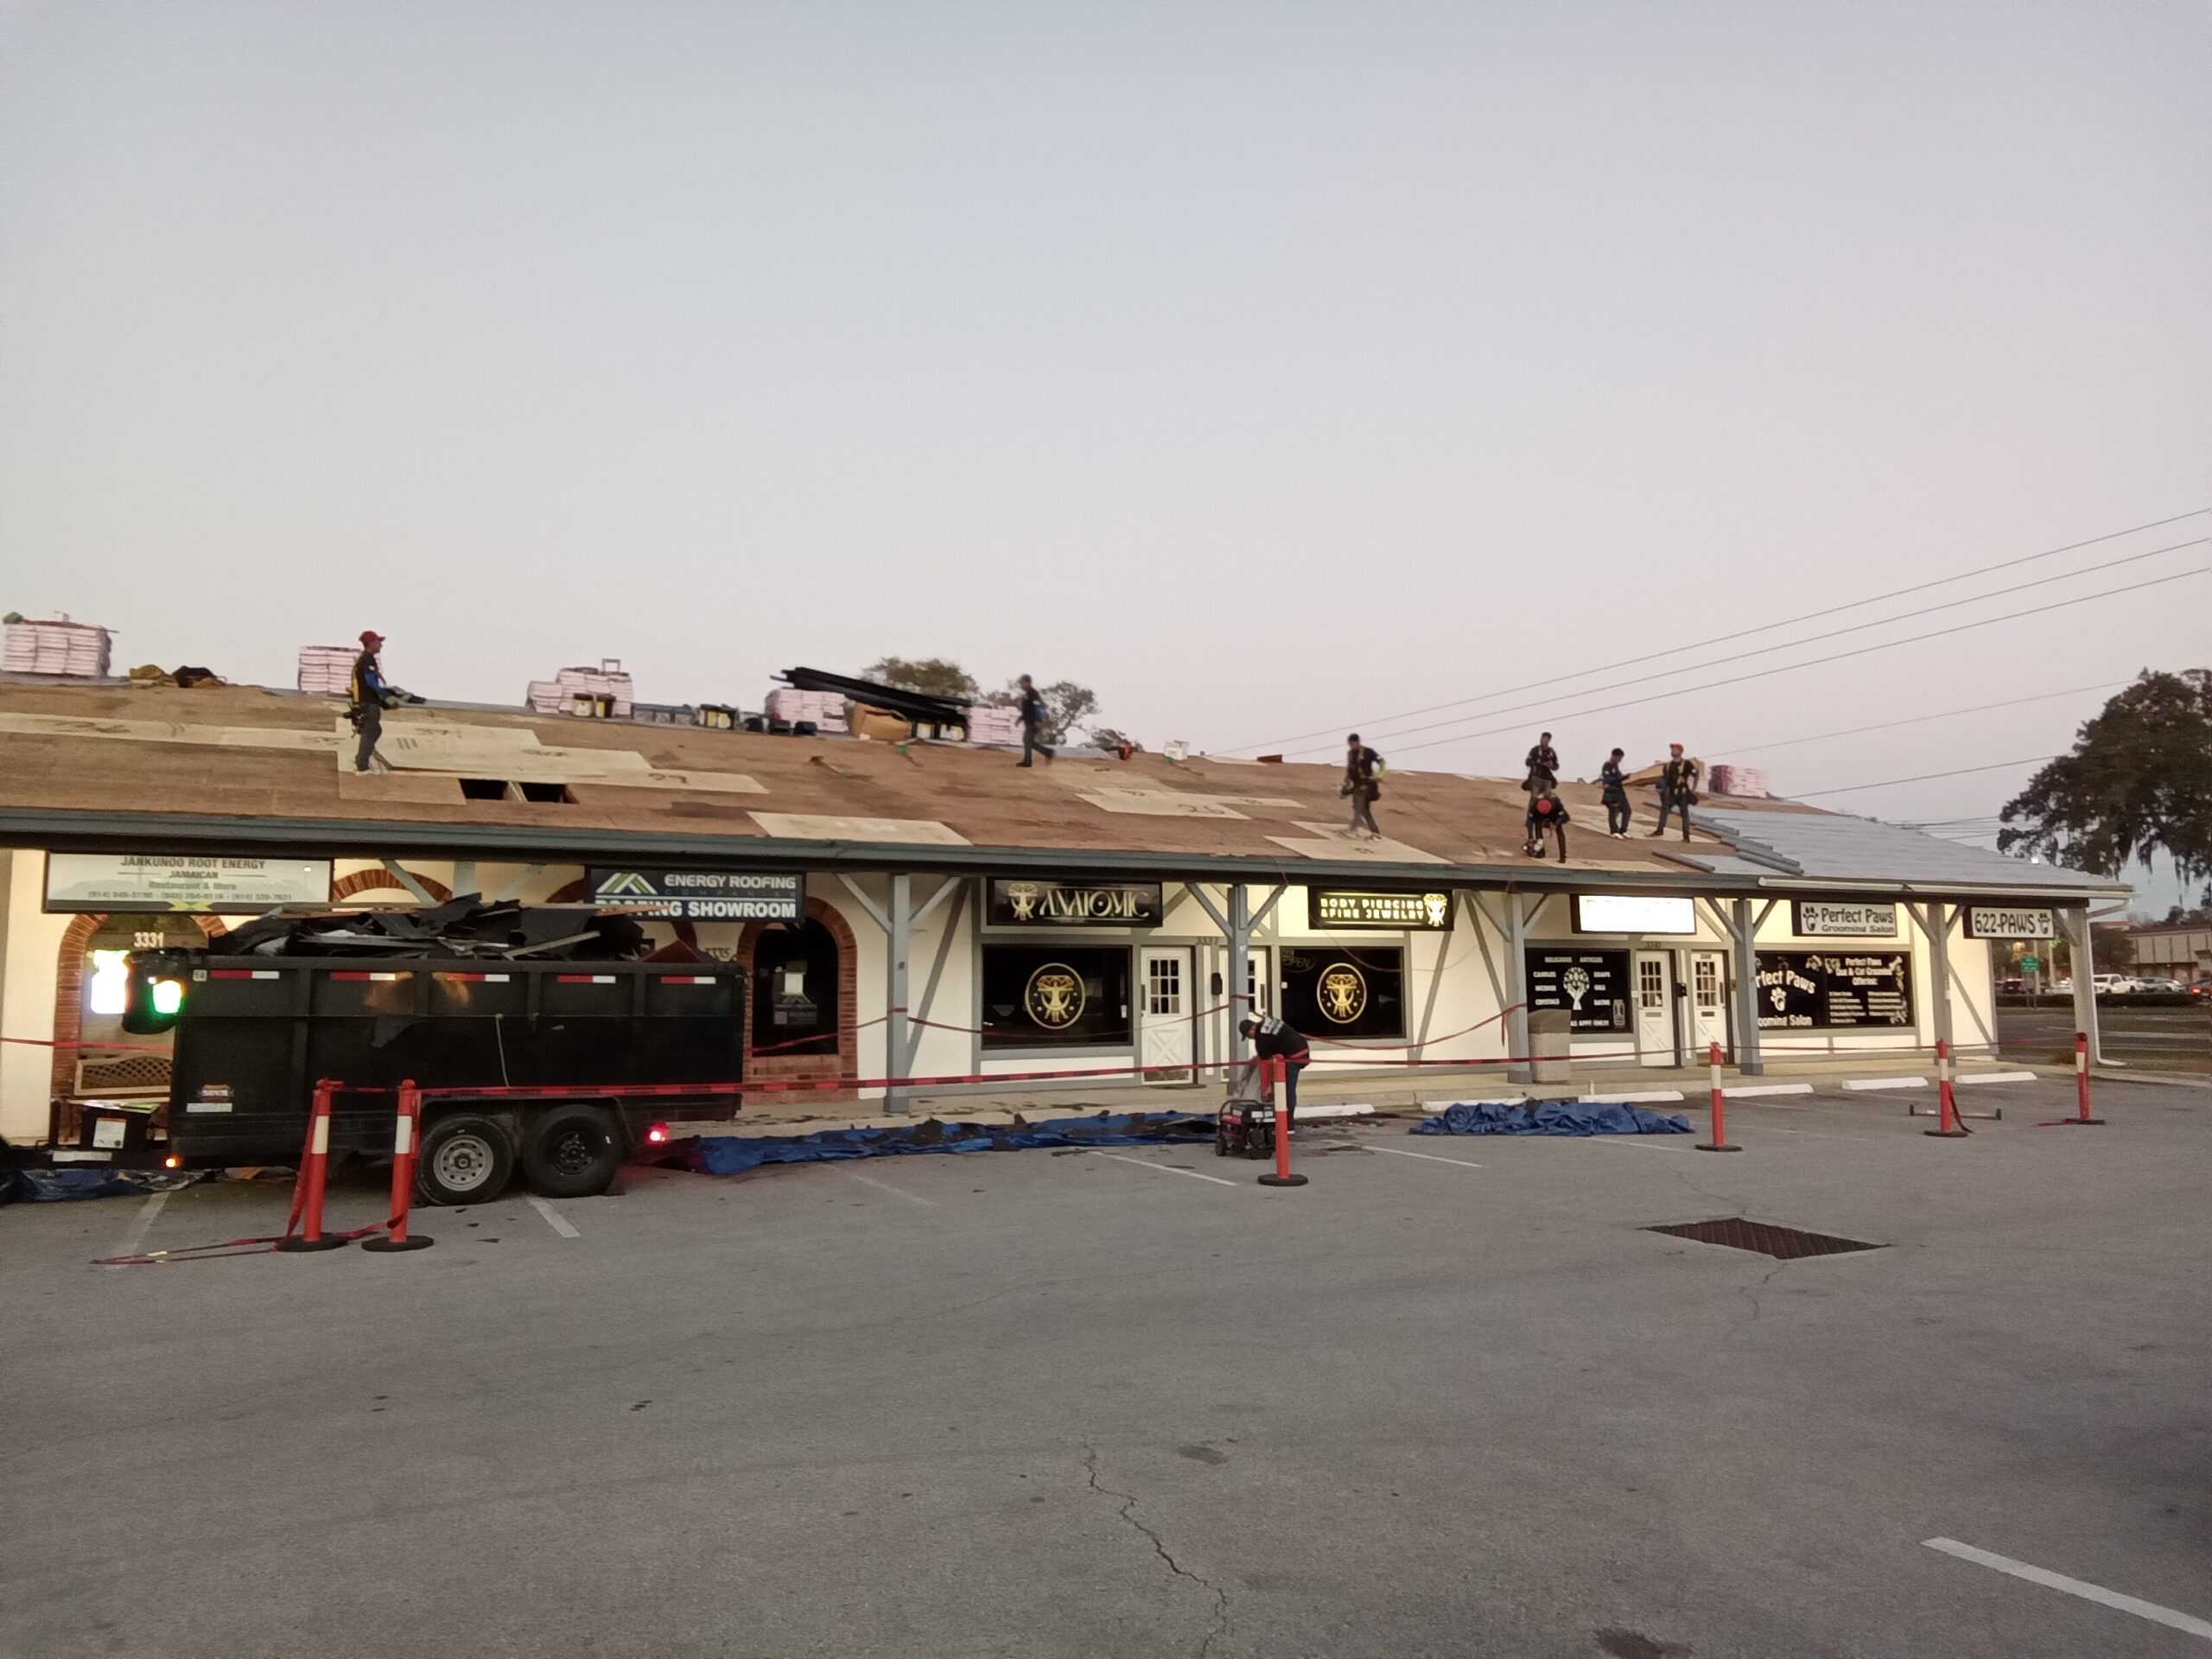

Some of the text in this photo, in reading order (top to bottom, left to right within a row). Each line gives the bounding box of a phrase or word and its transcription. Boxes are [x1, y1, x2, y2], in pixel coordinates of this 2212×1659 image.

[188, 858, 219, 868] ROOT
[222, 859, 265, 868] ENERGY
[664, 874, 797, 889] ENERGY ROOFING
[687, 901, 797, 918] SHOWROOM
[1320, 898, 1424, 910] BODY PIERCING
[1365, 909, 1424, 919] JEWELRY
[1821, 907, 1894, 923] Perfect Paws
[1974, 912, 2036, 934] 622-PAWS
[134, 931, 164, 948] 3331
[1755, 970, 1816, 994] rfect Paws
